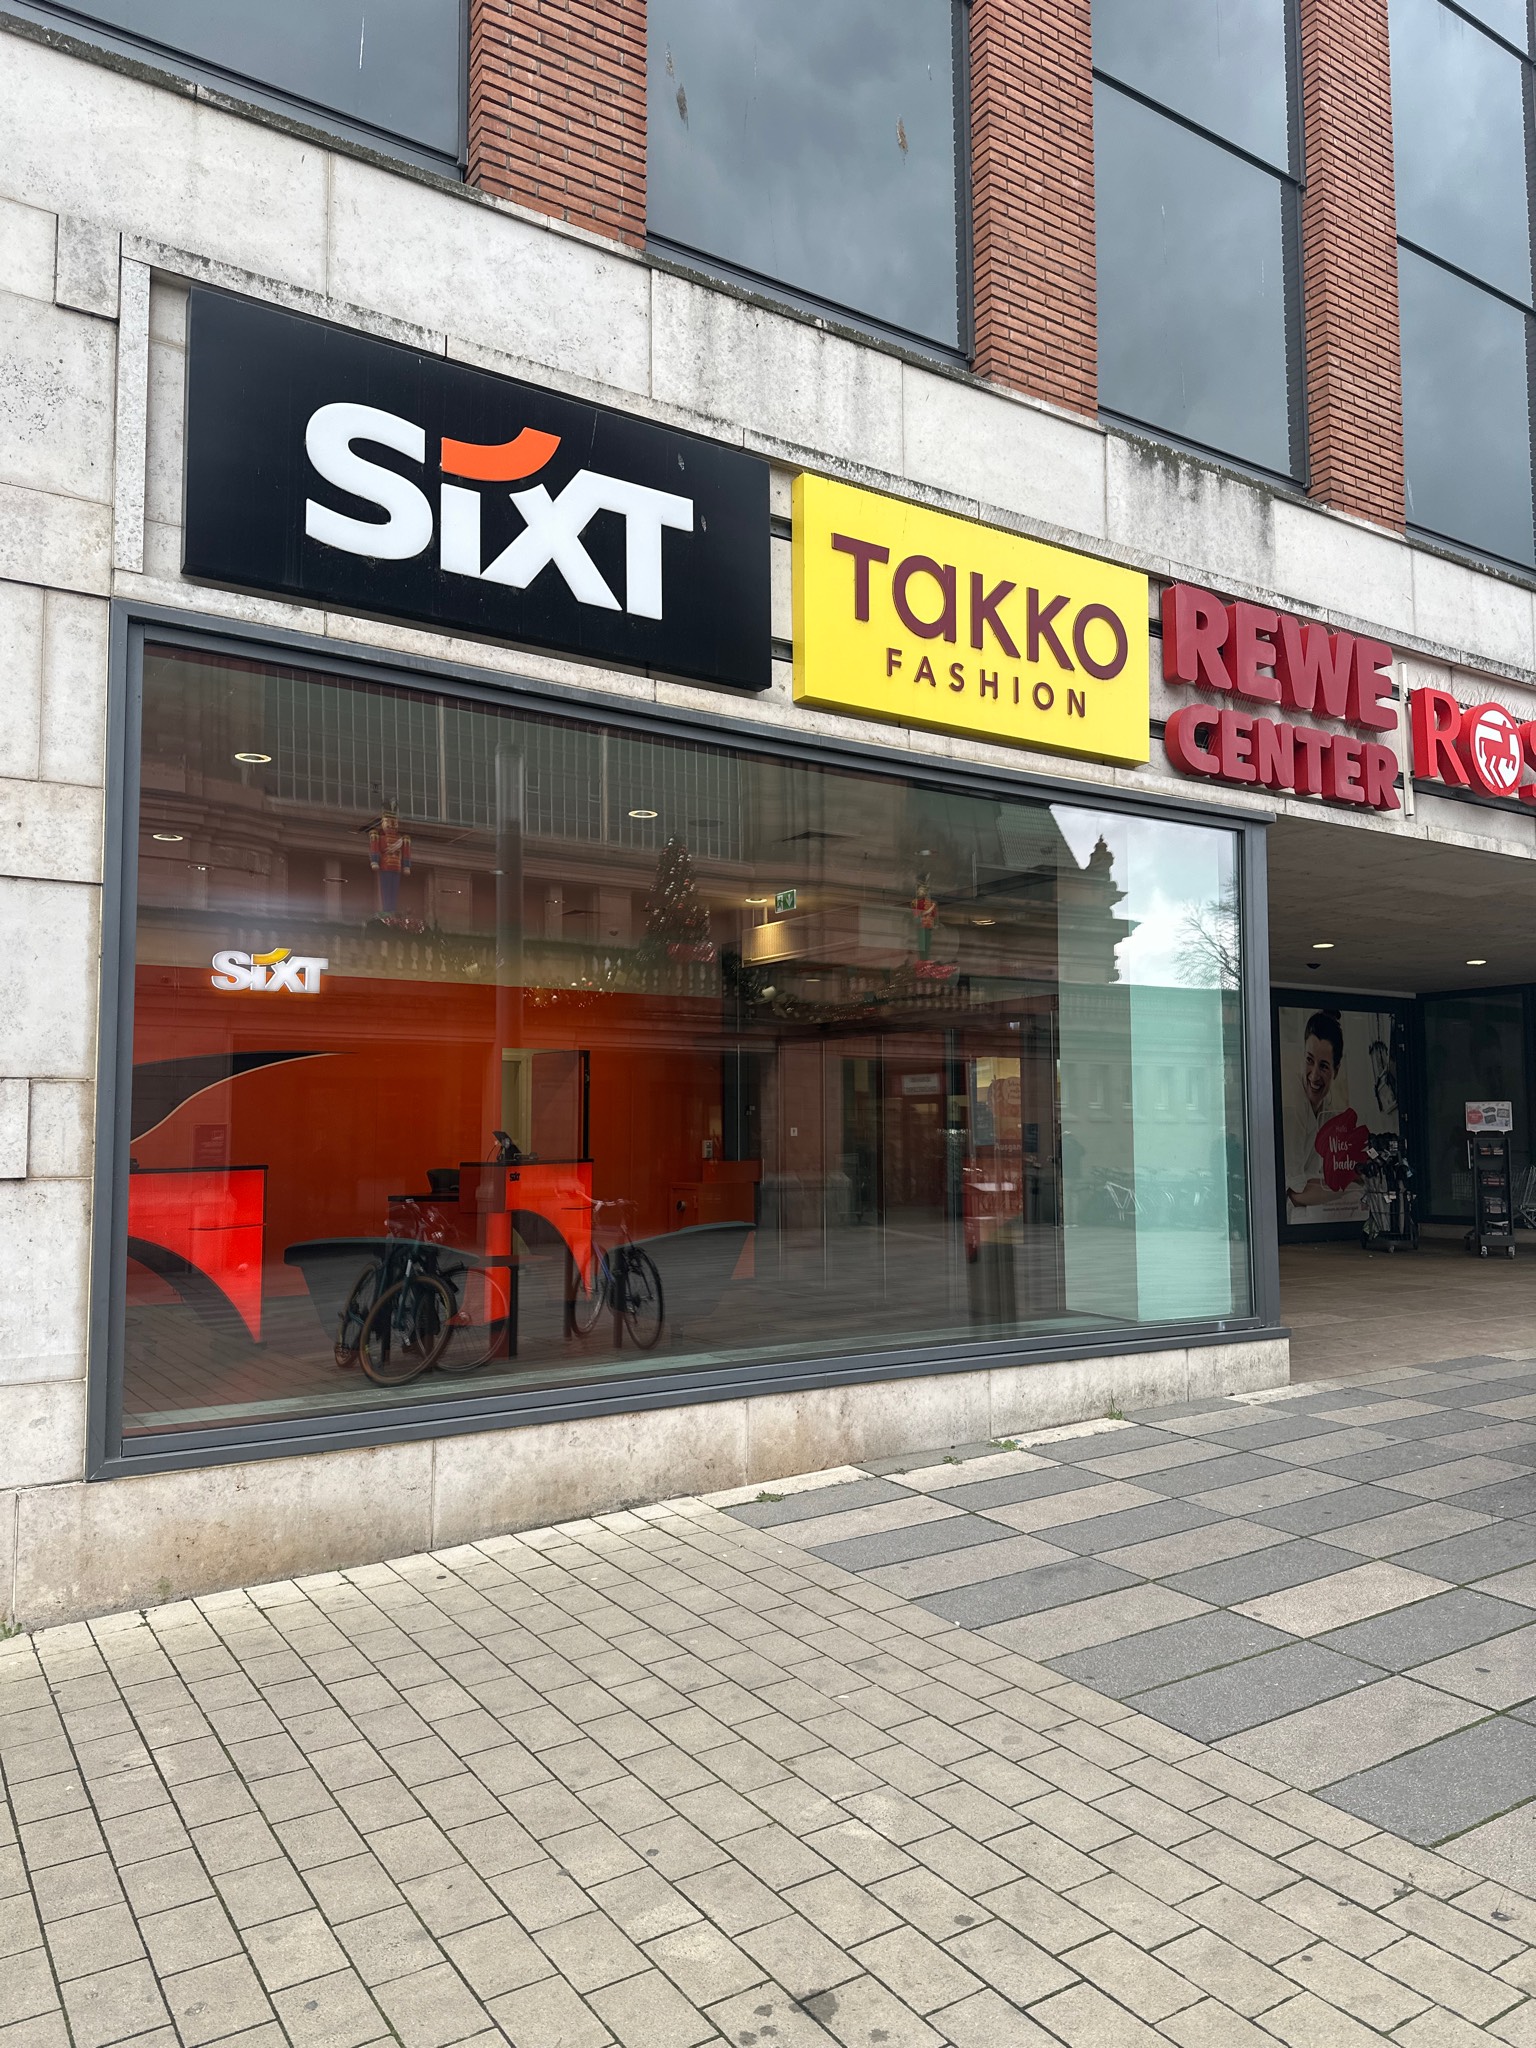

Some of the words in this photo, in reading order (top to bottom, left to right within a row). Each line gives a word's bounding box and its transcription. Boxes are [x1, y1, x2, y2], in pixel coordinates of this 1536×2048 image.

[886, 647, 1086, 718] FASHION
[1162, 583, 1398, 733] REWE
[1165, 704, 1400, 812] CENTER
[1411, 687, 1536, 807] RO
[1330, 1136, 1352, 1153] Wies-
